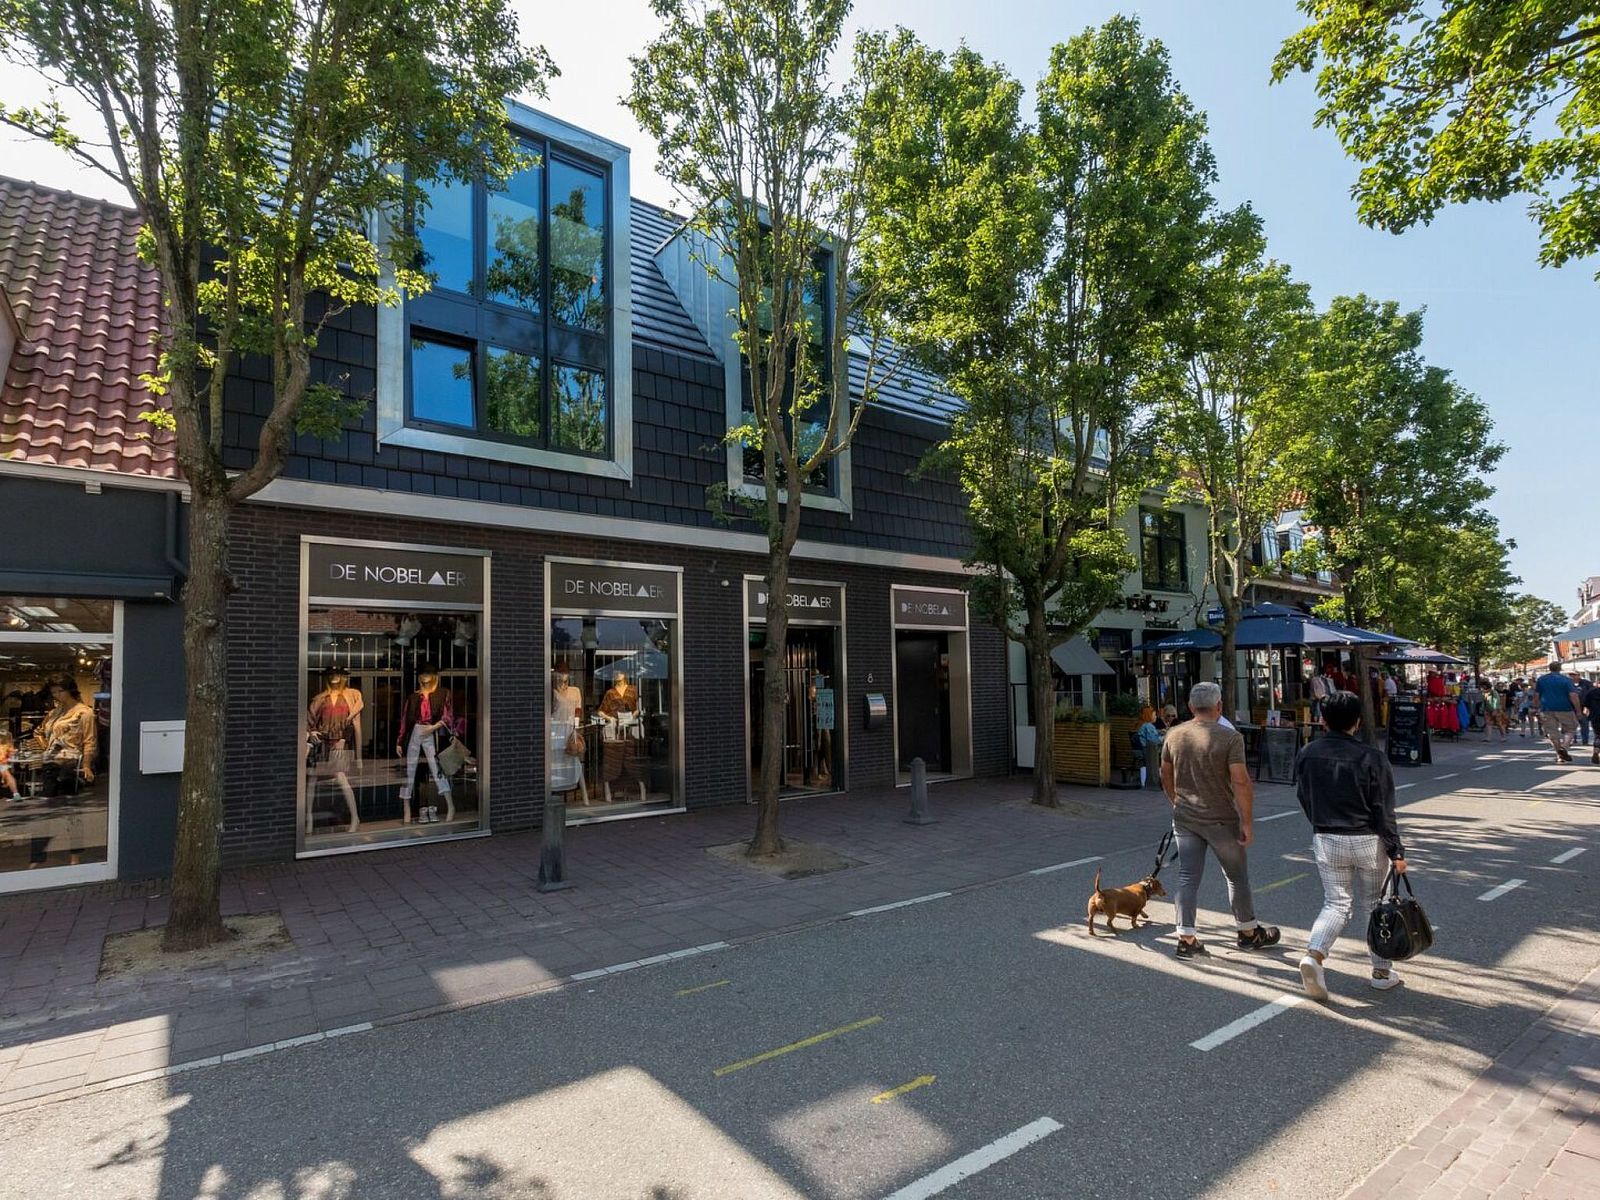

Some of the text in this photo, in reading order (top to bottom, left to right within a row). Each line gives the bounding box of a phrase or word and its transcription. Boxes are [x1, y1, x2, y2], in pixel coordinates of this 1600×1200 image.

[330, 564, 356, 581] DE
[565, 580, 584, 594] DE
[758, 592, 832, 608] D OBELAER
